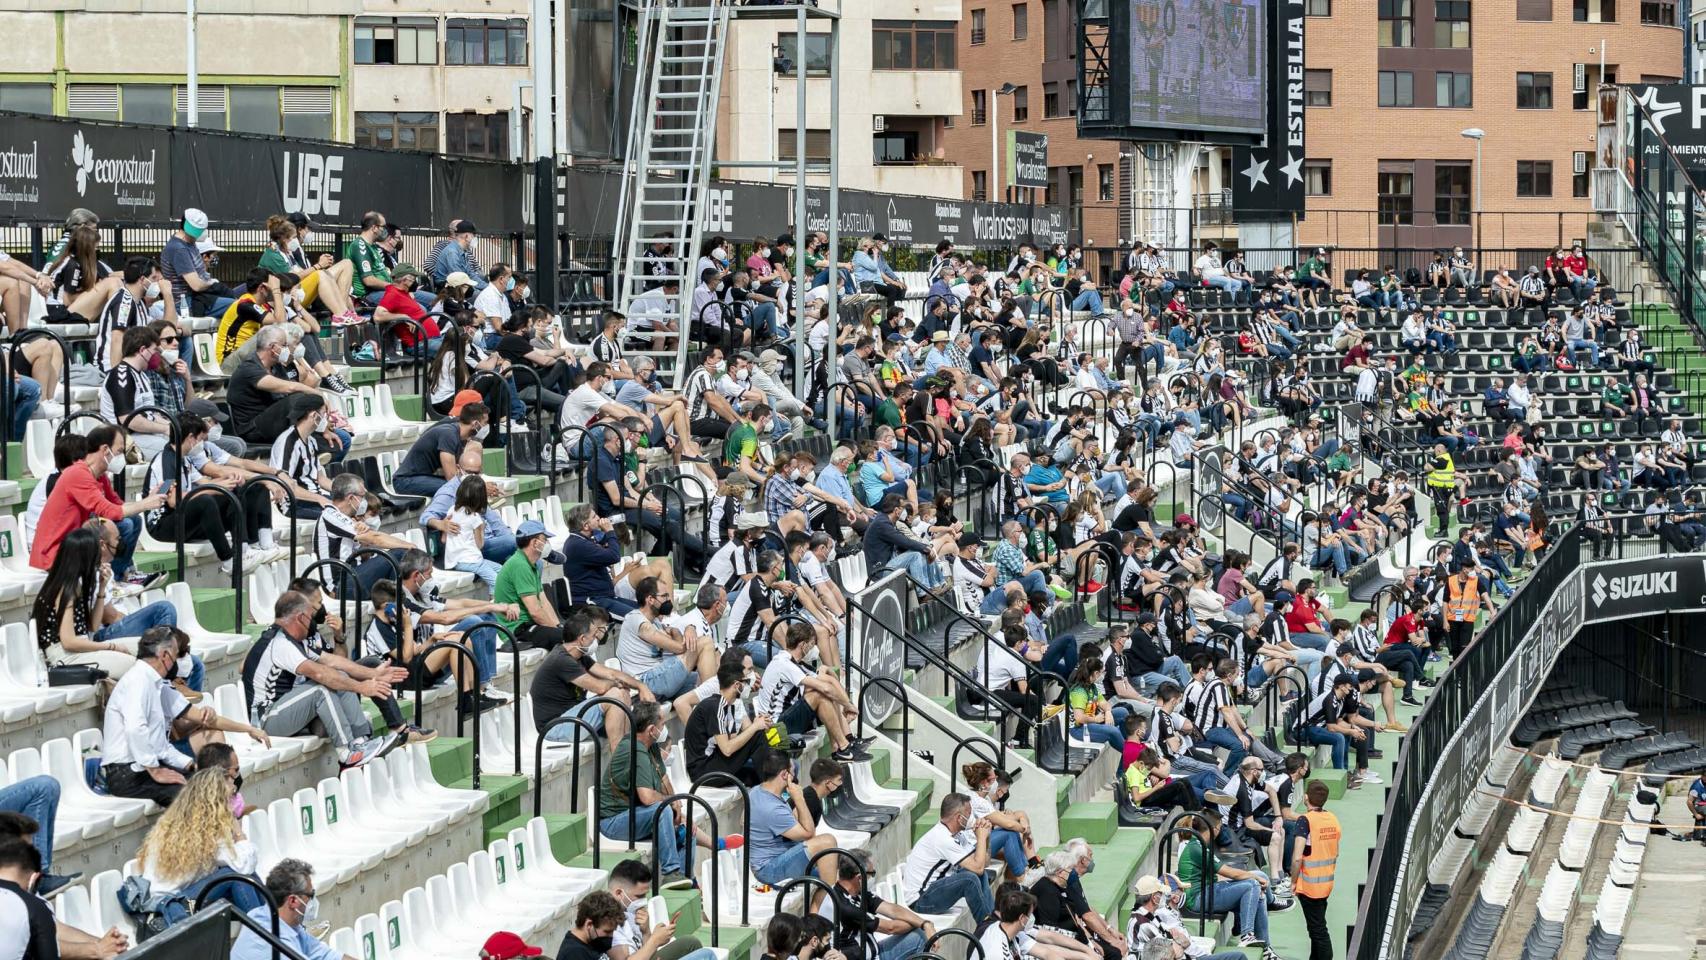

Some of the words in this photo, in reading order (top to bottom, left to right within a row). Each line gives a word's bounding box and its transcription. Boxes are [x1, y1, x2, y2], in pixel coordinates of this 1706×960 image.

[1288, 17, 1303, 147] ESTRELLA
[95, 149, 156, 195] ecopostural
[1645, 145, 1706, 155] AISMIENT
[283, 151, 344, 216] UBE
[1609, 570, 1678, 600] SUZUKI
